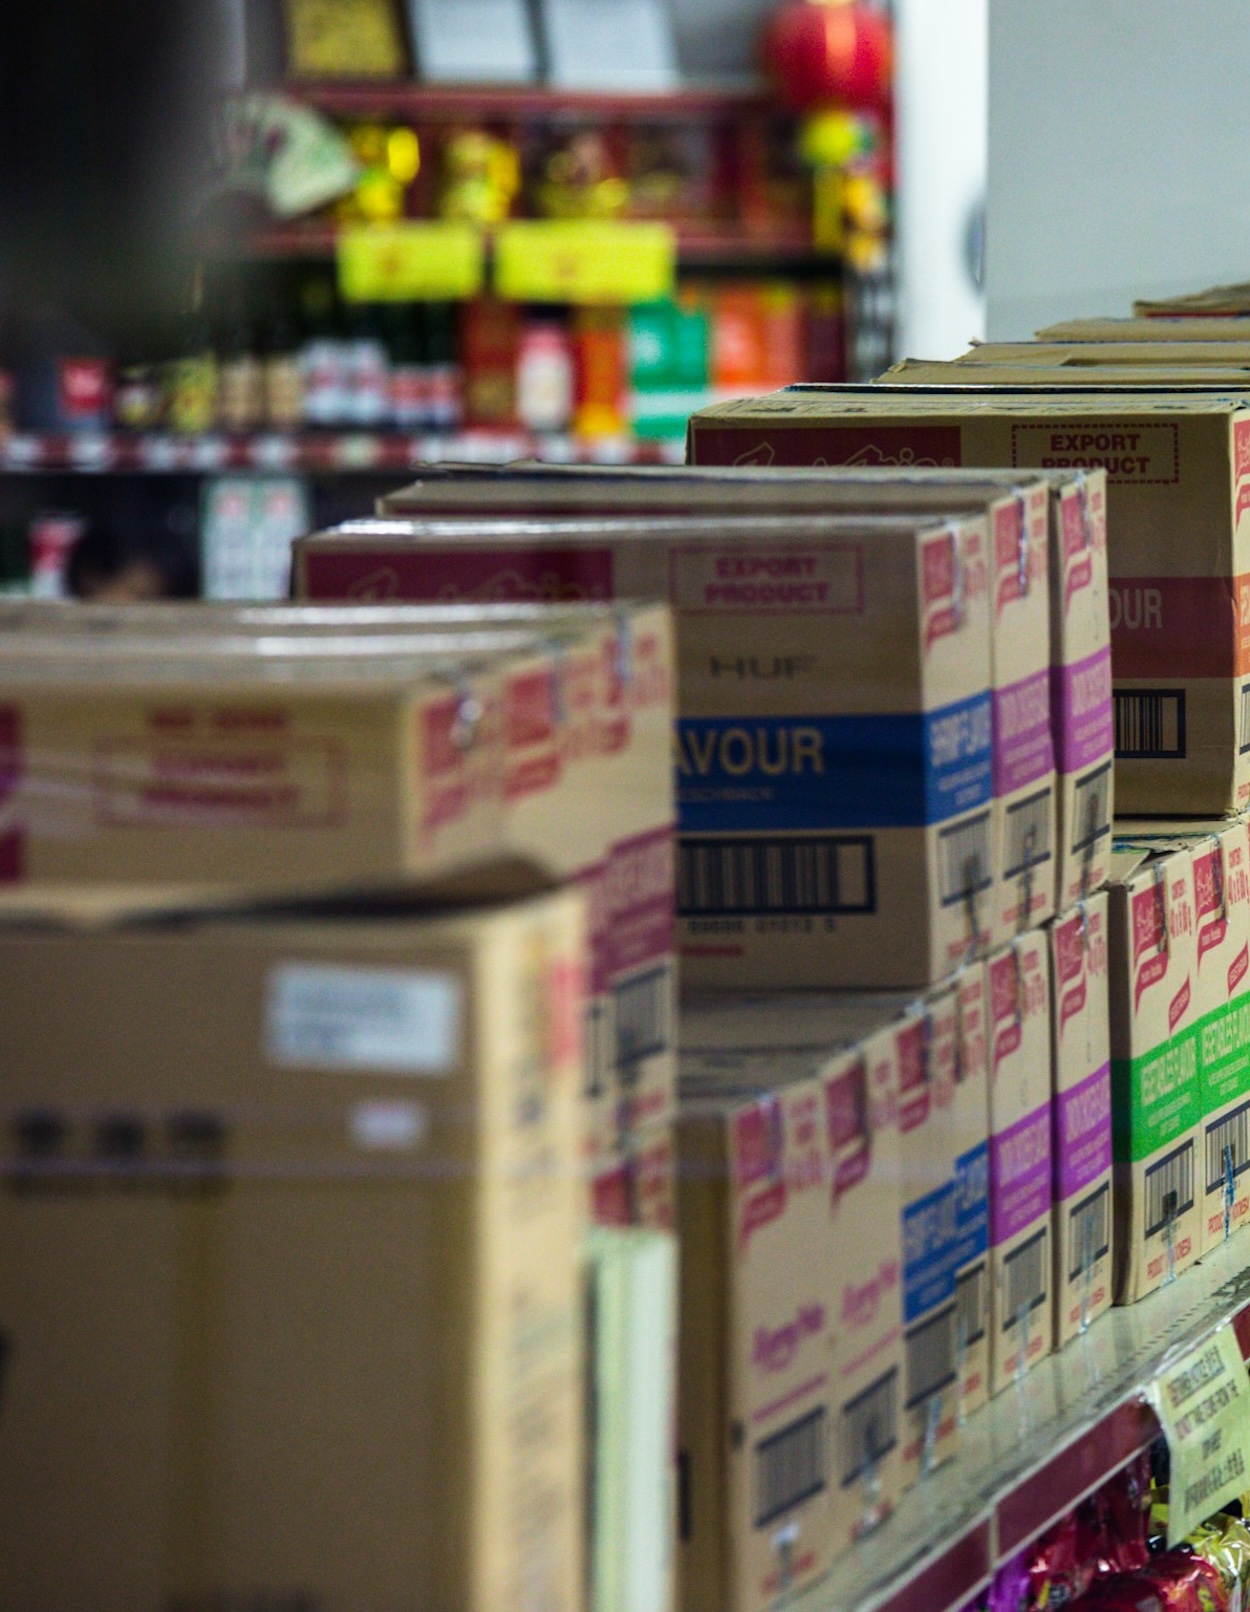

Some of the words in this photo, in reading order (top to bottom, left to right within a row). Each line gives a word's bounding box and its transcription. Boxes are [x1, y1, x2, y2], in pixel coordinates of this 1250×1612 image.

[1051, 434, 1140, 452] EXPORT
[1041, 456, 1150, 475] PRODUCT
[715, 556, 819, 578] EXPORT
[705, 581, 832, 604] PRODUCT
[1109, 588, 1163, 629] OUR
[675, 727, 824, 776] AVOUR
